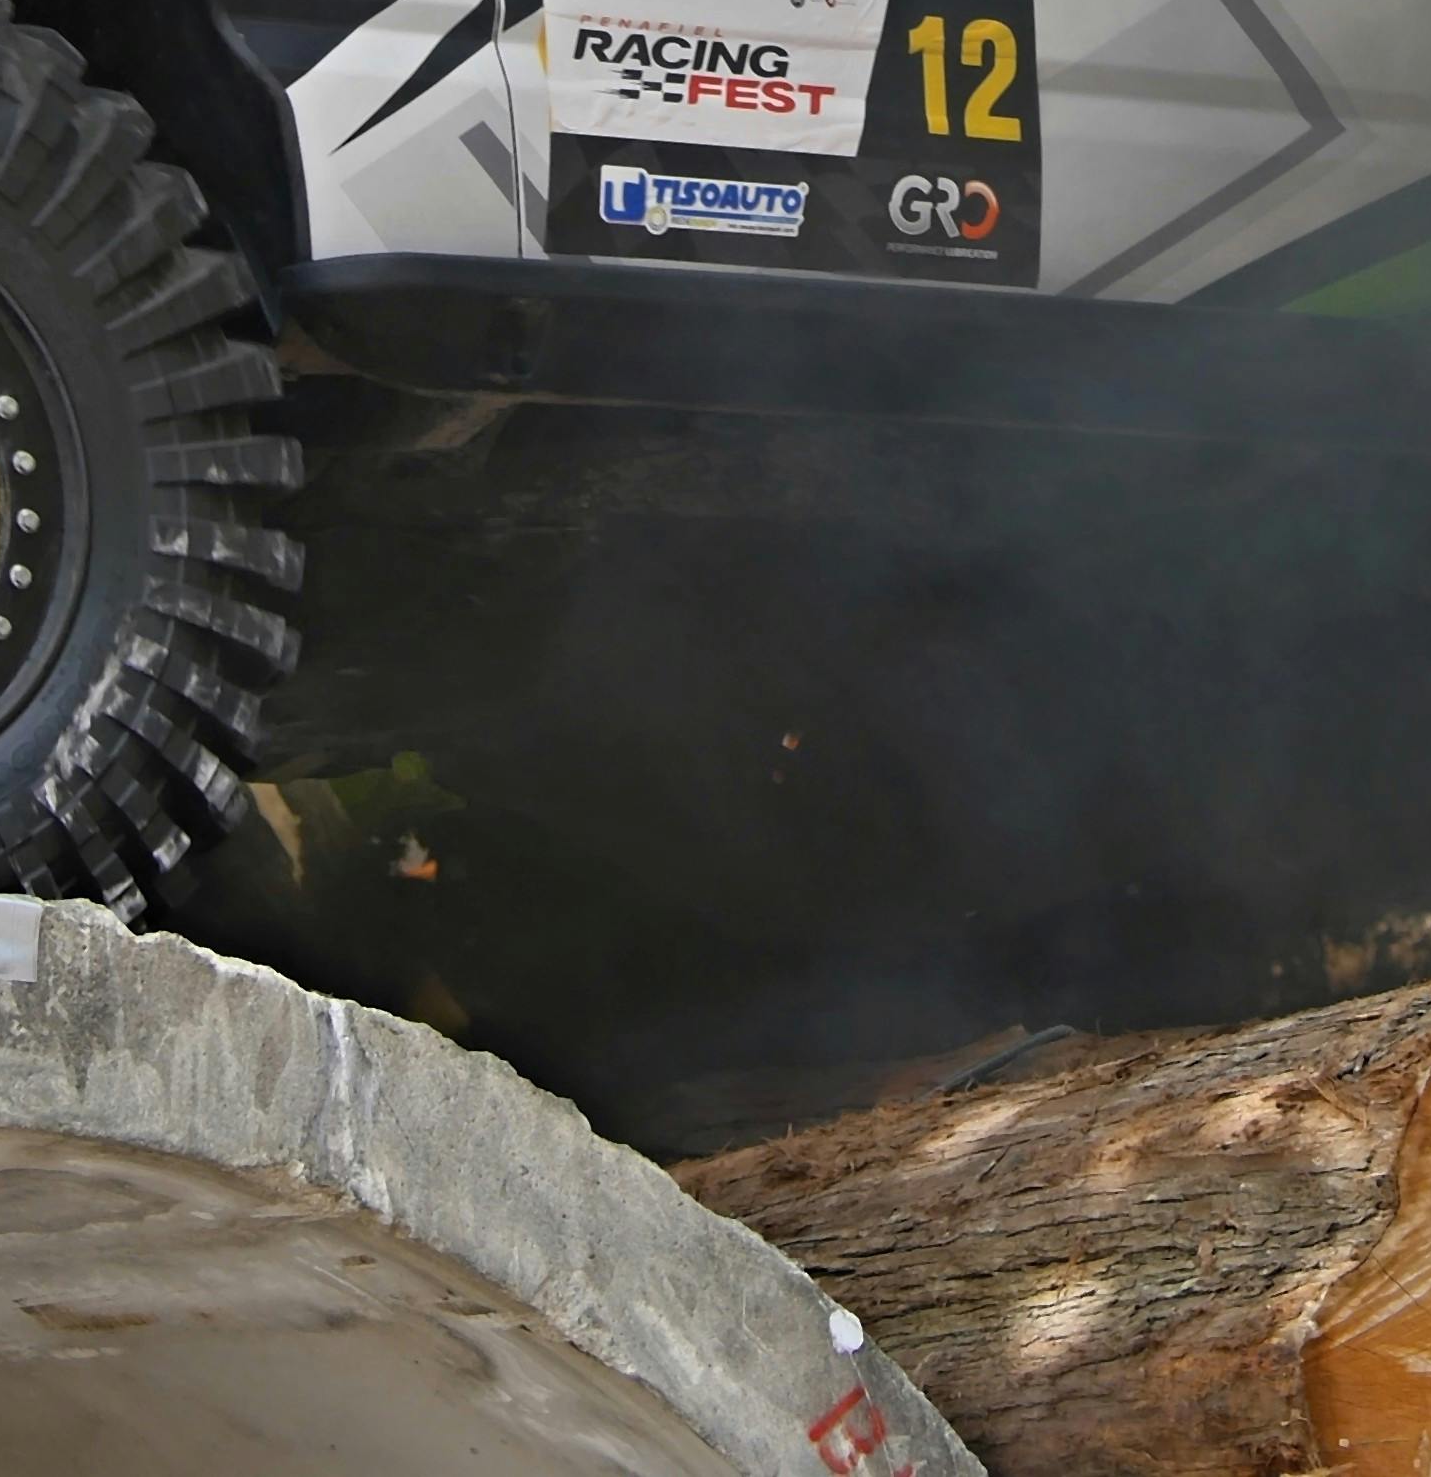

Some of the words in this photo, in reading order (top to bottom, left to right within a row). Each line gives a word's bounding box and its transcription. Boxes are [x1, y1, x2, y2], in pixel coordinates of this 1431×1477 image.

[579, 13, 724, 39] PENAFIEL
[573, 29, 789, 79] RACING
[687, 75, 836, 116] FEST
[908, 15, 1022, 142] 12
[652, 178, 803, 214] TISOAUTO
